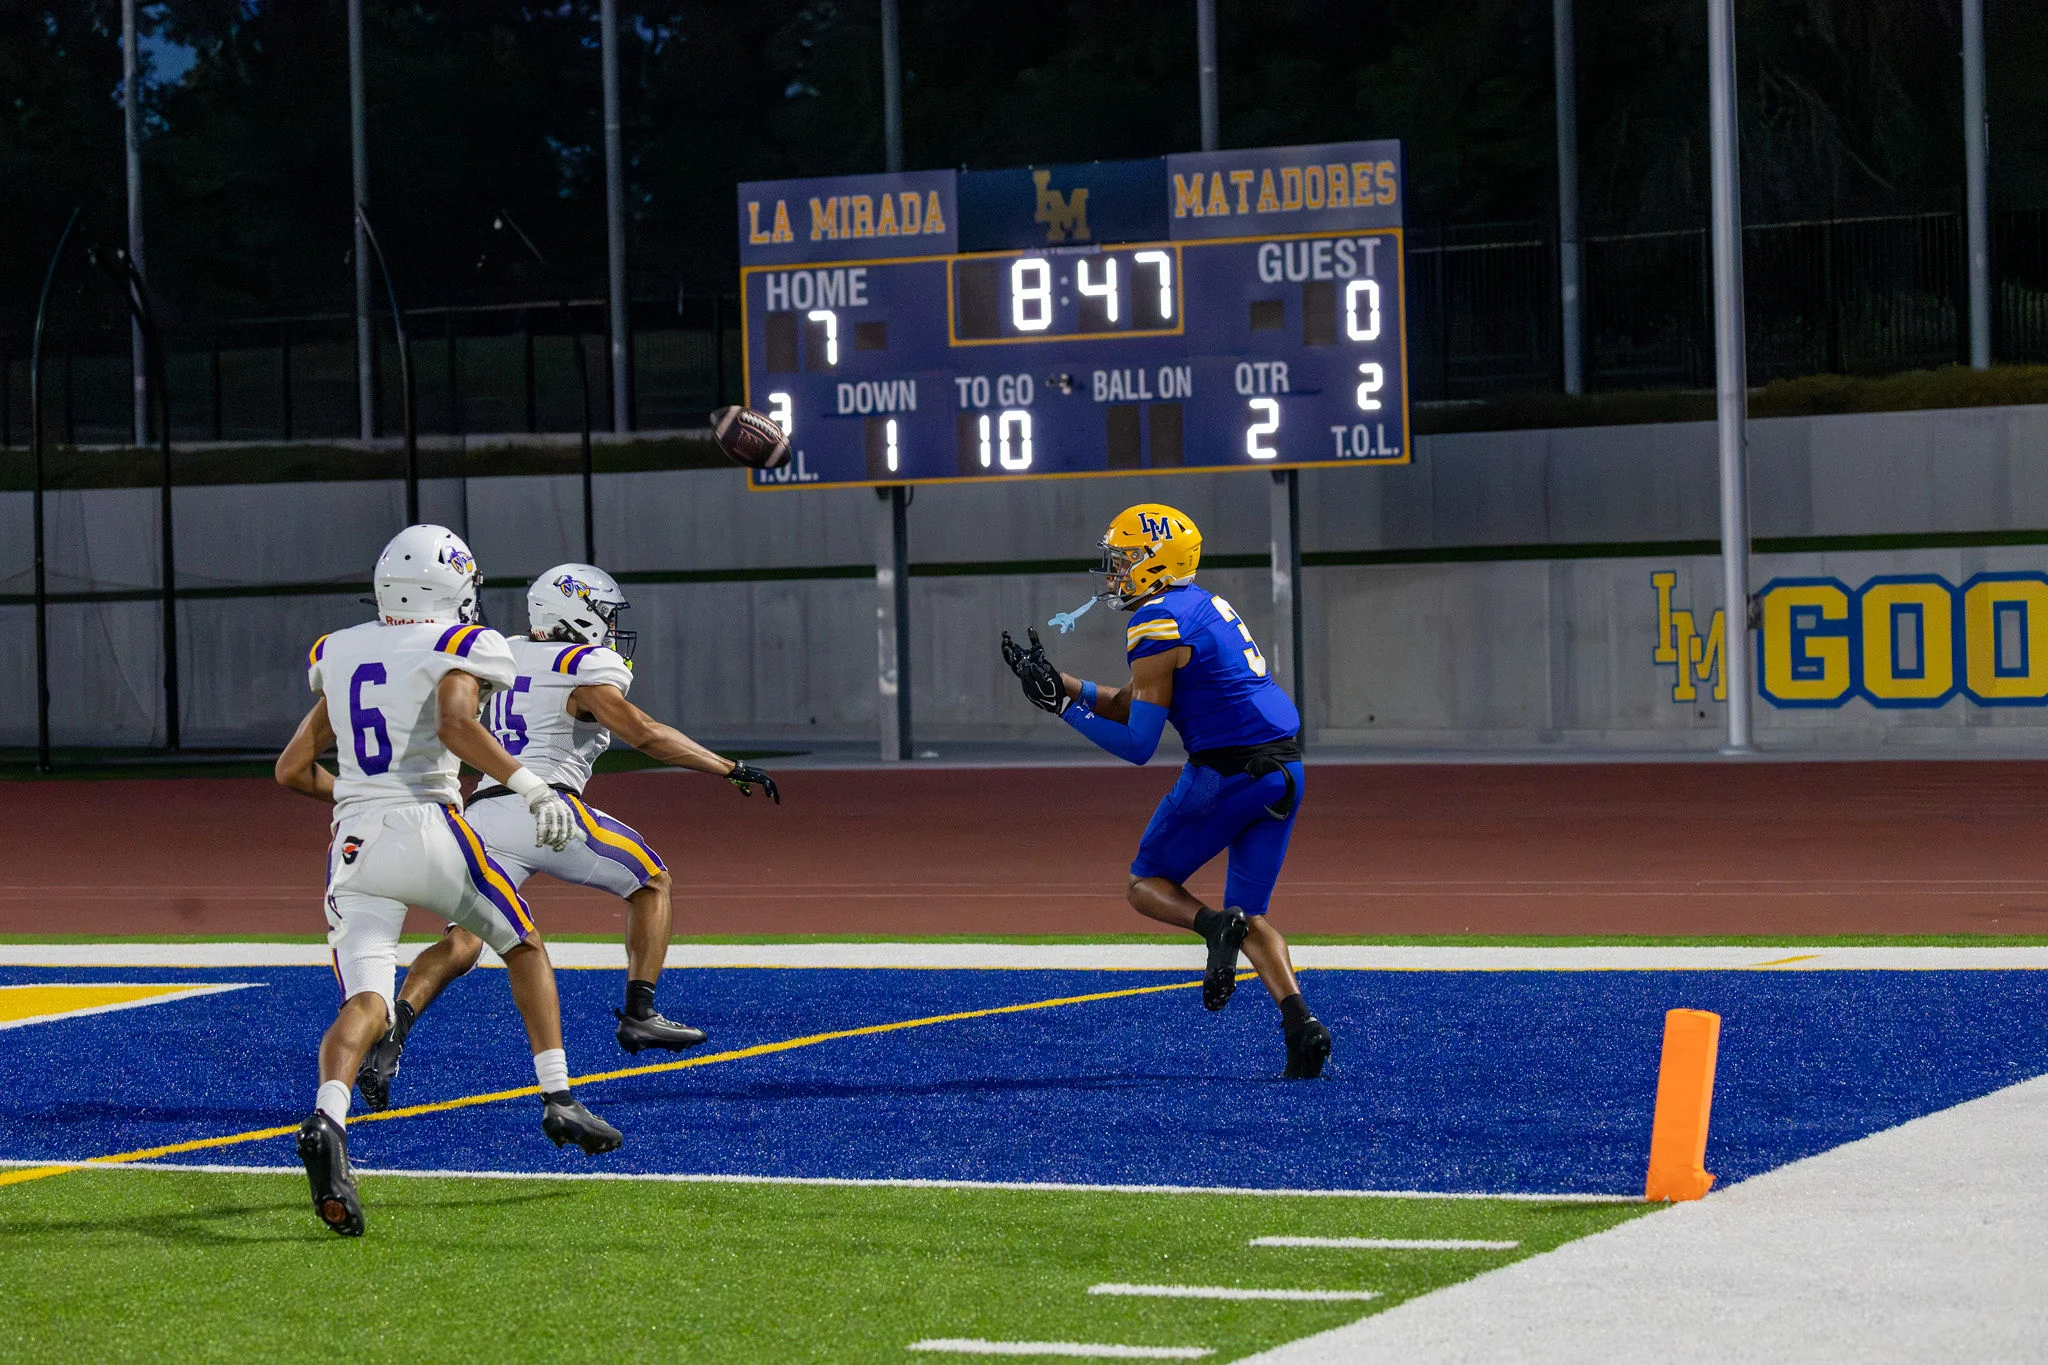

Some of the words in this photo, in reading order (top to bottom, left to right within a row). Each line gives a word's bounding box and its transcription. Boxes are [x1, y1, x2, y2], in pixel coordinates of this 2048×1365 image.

[1174, 160, 1397, 217] MATADORES
[748, 200, 793, 244] LA
[809, 191, 946, 240] MIRADA
[1258, 238, 1381, 283] GUEST
[766, 268, 868, 311] HOME
[1011, 251, 1171, 331] 8:47
[1346, 280, 1380, 341] 0
[808, 311, 837, 365] 7
[837, 380, 917, 414] DOWN
[955, 376, 990, 408] TO
[997, 374, 1034, 406] GO
[1093, 368, 1153, 401] BALL
[1158, 366, 1192, 398] ON
[1235, 361, 1290, 395] QTR
[1357, 363, 1383, 410] 2
[886, 419, 898, 472] 1
[979, 410, 1033, 470] 10
[1246, 398, 1280, 459] 2
[1331, 424, 1399, 458] T.O.L.
[1137, 512, 1174, 542] LM
[1211, 595, 1267, 677] 3
[349, 662, 393, 777] 6
